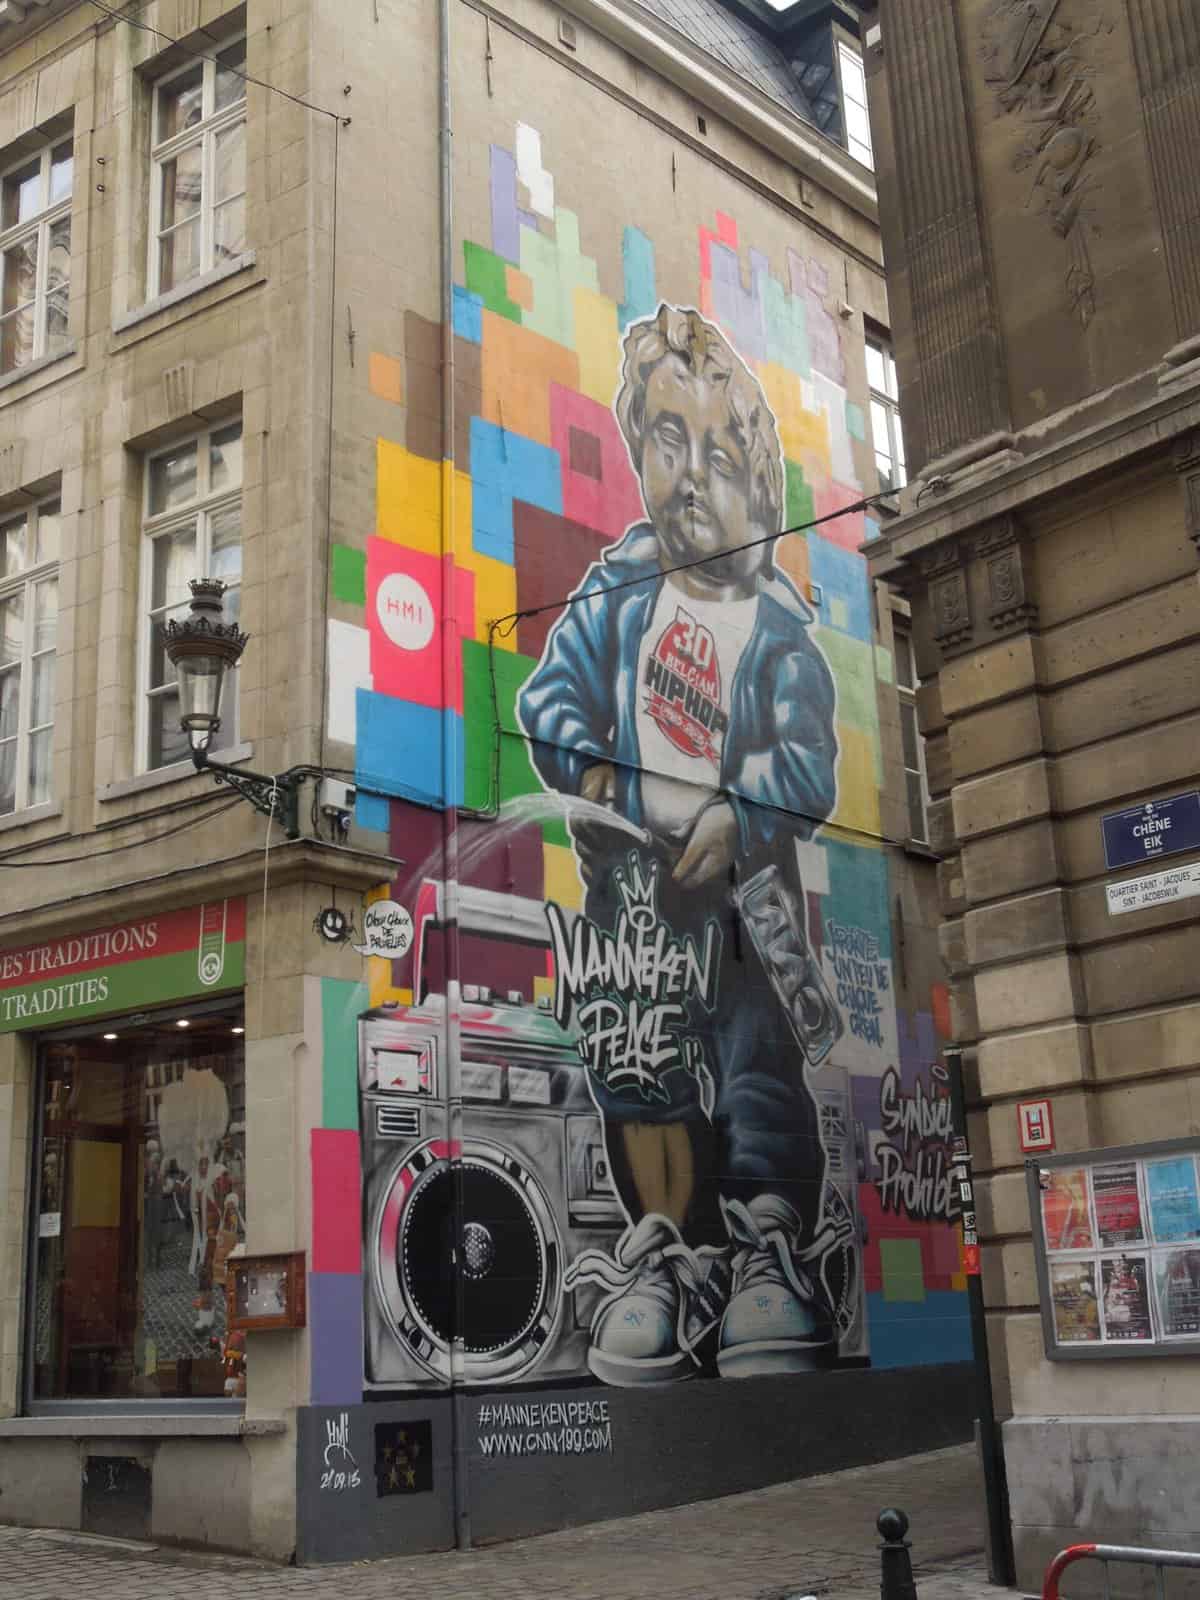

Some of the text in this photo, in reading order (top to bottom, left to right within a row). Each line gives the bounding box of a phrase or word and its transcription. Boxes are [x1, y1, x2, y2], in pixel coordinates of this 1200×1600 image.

[671, 605, 716, 669] 30
[1143, 834, 1163, 850] EIK
[1109, 884, 1138, 900] QUARTIER
[26, 922, 158, 974] TRADITIONS
[546, 903, 714, 1021] MANNEKEN
[1, 976, 109, 1021] TRADITIES
[478, 1399, 611, 1428] #MANNEKENPEACE
